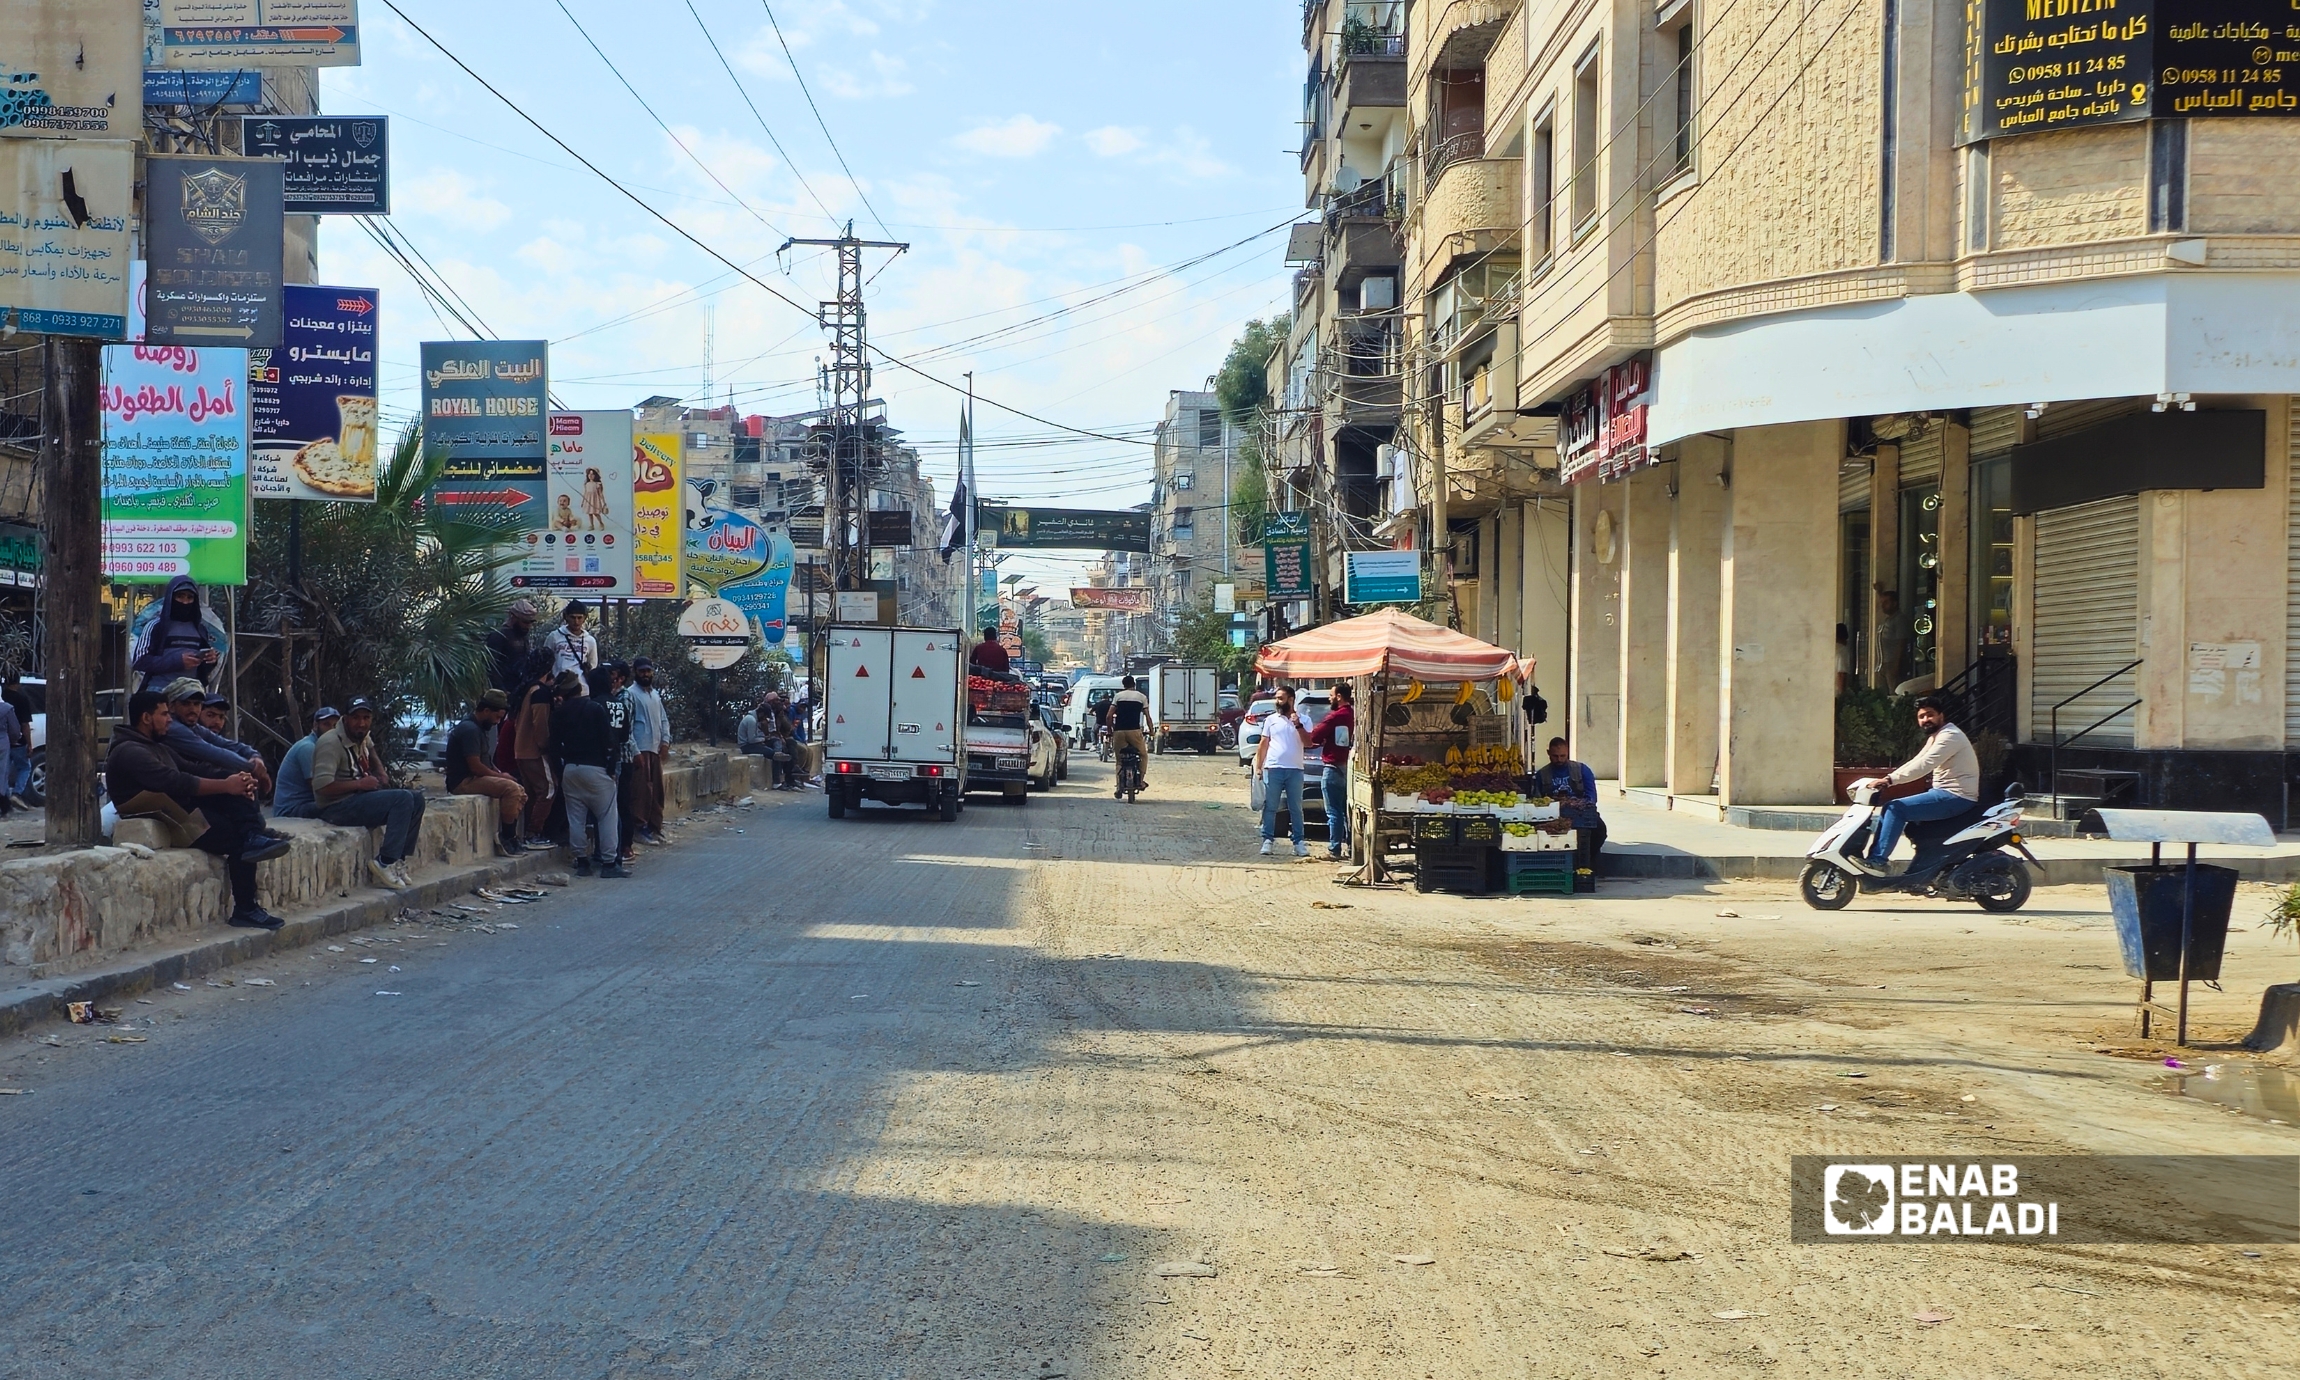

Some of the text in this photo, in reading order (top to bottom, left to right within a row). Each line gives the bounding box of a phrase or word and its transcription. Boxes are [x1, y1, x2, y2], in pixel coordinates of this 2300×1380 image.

[1994, 14, 2148, 56] كل ما تحتاجه بشرتك
[2168, 21, 2270, 43] مكياجات عالمية
[233, 47, 264, 57] مقابل
[316, 47, 336, 56] شارع
[2026, 54, 2127, 82] 0958 11 24 85
[2181, 68, 2282, 84] 0958 11 24 85
[2047, 85, 2083, 101] ساحة
[2096, 78, 2127, 98] داريا
[2173, 88, 2298, 112] جامع العباس
[22, 105, 109, 118] 0998459700
[2000, 99, 2121, 129] باتجاه جامع العباس
[22, 118, 109, 132] 0987371555
[289, 123, 342, 144] المحامي
[303, 147, 338, 169] ذيب
[341, 150, 382, 168] جمال
[284, 170, 381, 185] استشارات مرافعات
[0, 211, 30, 229] والمط
[186, 206, 241, 221] جند الشام
[0, 240, 112, 261] تجهيزات بمكابس إيطال
[177, 247, 249, 265] SHAM
[0, 263, 121, 285] سرعة بالأداء وأسعار مدر
[156, 289, 267, 304] مستلزمات عسكرية
[22, 311, 121, 331] 868 0933 927 271
[289, 316, 373, 335] بيتزا و معجنات
[289, 344, 372, 366] مايسترو
[288, 373, 373, 390] إدارة رائد شربجي
[426, 358, 542, 389] البيت الملكي
[99, 378, 236, 422] أمل الطفولة
[431, 396, 539, 418] ROYAL HOUSE
[555, 417, 580, 425] Mama
[215, 435, 239, 452] طفولة
[562, 440, 584, 453] ماما
[638, 437, 677, 468] Delivery
[257, 465, 278, 474] شركة
[483, 460, 543, 480] معضماني
[636, 506, 669, 521] توصيل
[1275, 515, 1300, 526] الدكتور
[649, 523, 660, 538] في
[707, 522, 757, 555] البيان
[1265, 526, 1308, 537] وسيم الصادق
[109, 542, 177, 554] 0993 622 103
[108, 561, 177, 573] 0960 909 489
[592, 577, 605, 585] 250
